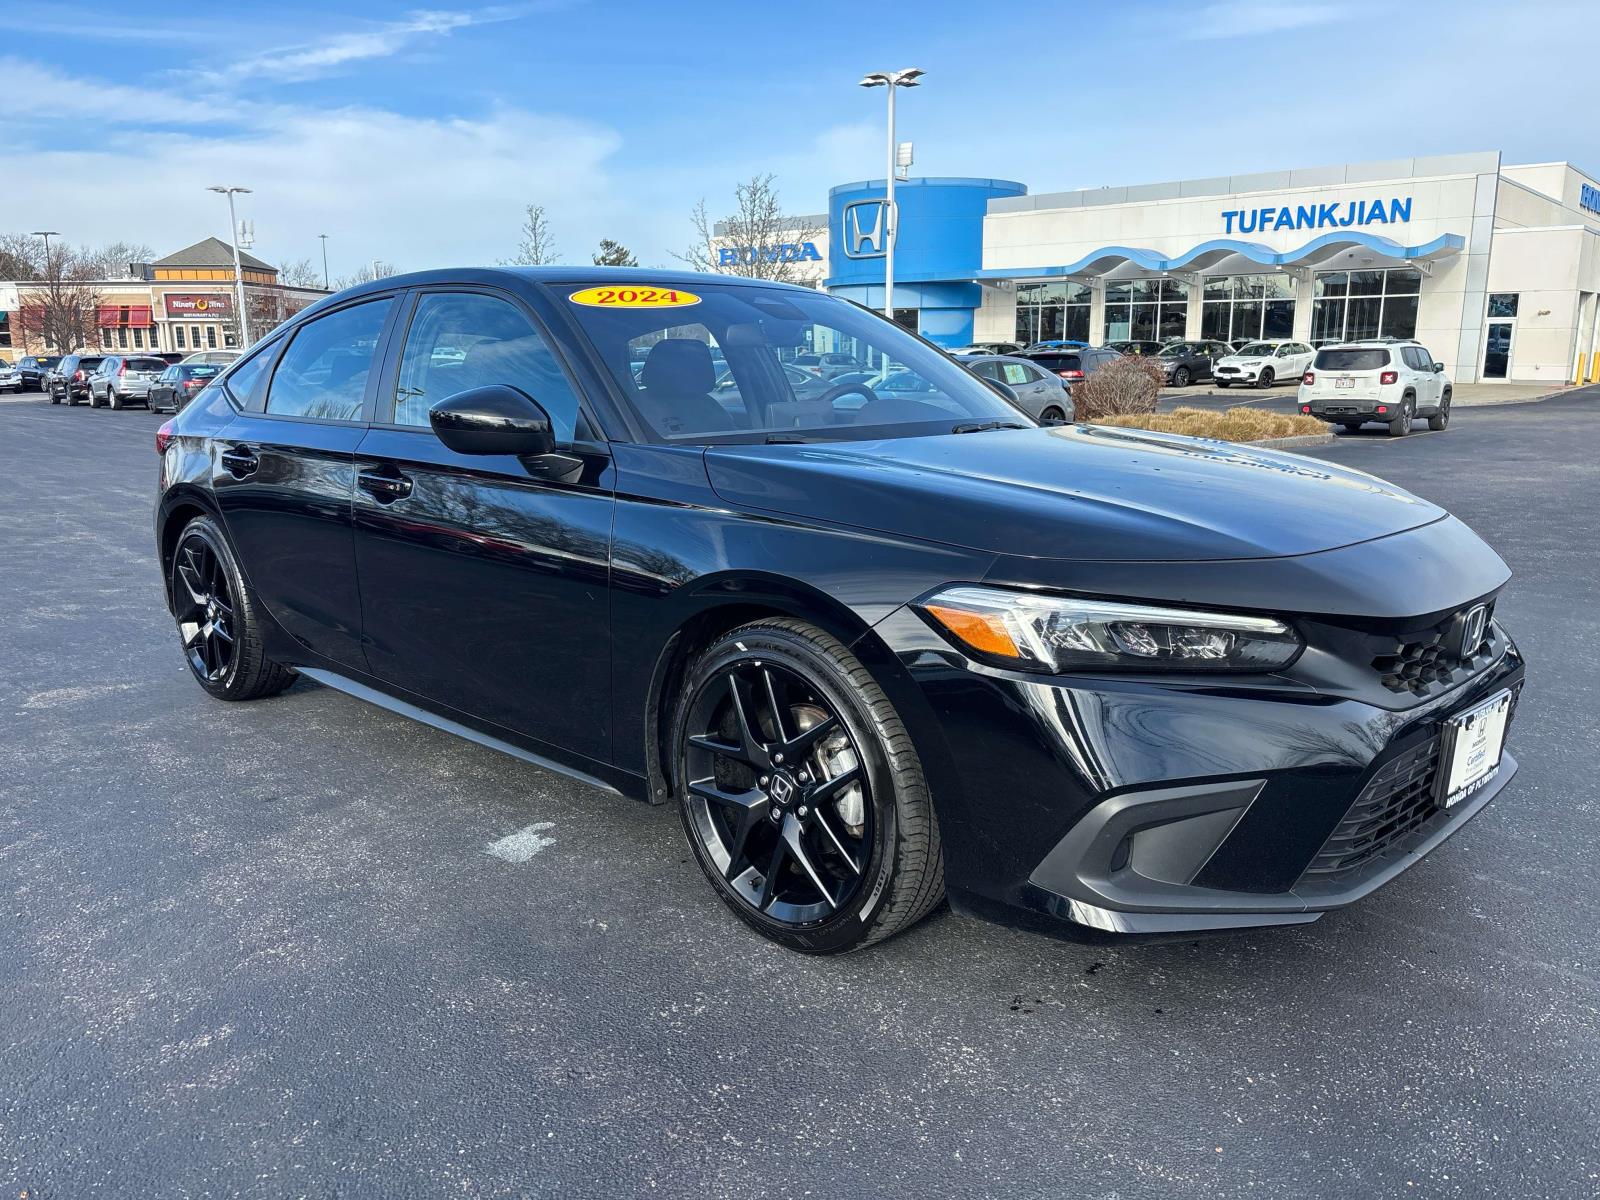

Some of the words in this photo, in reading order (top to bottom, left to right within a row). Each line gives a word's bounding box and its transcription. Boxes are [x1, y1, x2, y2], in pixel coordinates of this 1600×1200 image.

[1221, 197, 1412, 234] TUFANKJIAN
[718, 241, 823, 267] HONDA
[597, 290, 680, 304] 2024
[1446, 788, 1467, 808] HONDA
[1467, 784, 1475, 796] OF
